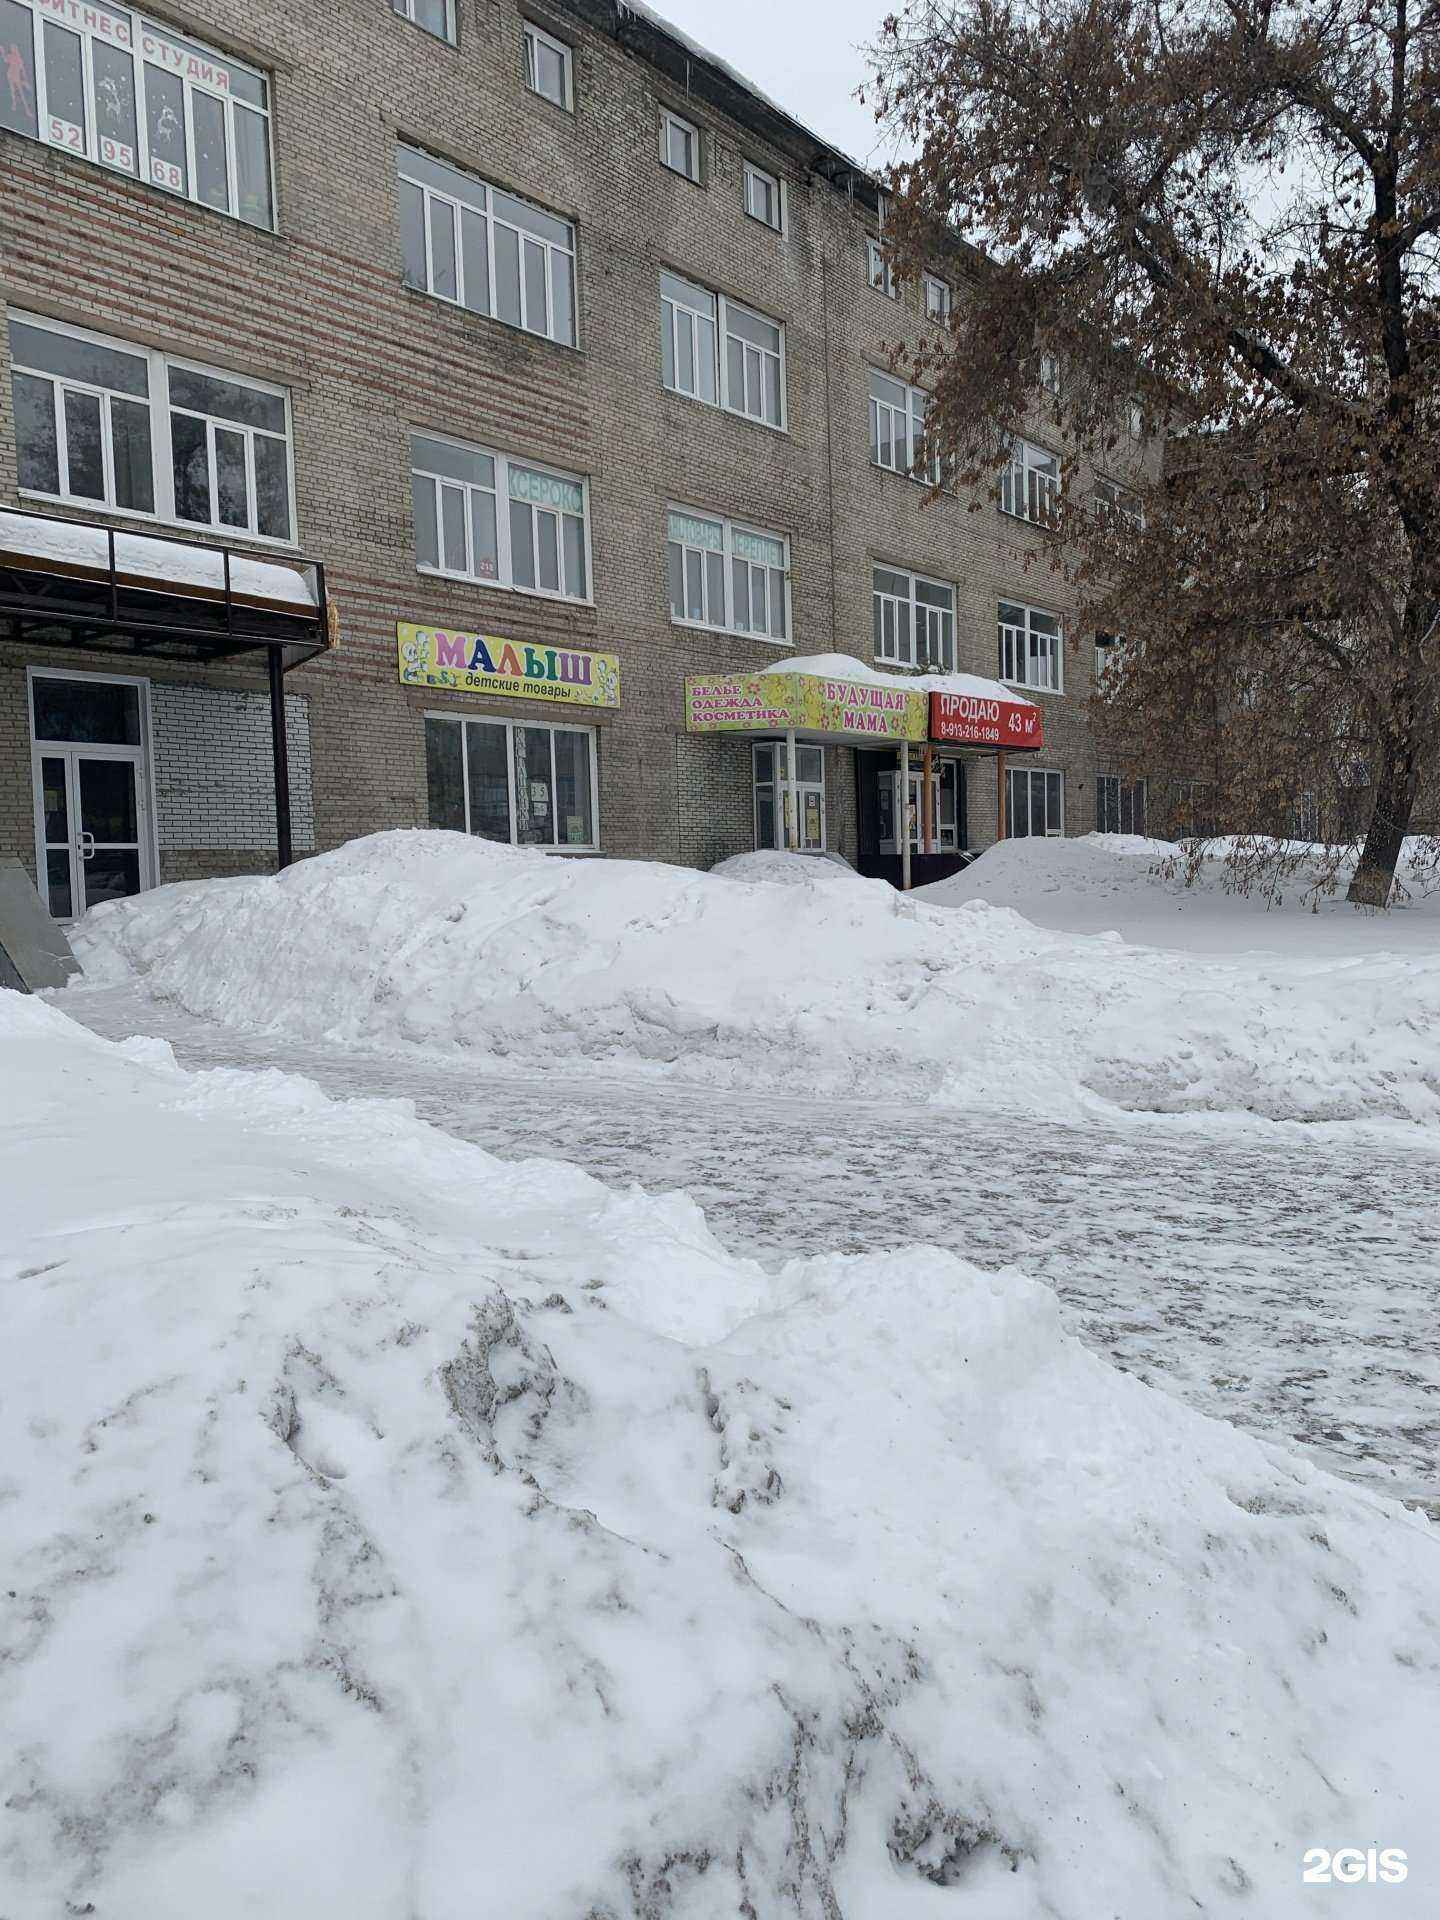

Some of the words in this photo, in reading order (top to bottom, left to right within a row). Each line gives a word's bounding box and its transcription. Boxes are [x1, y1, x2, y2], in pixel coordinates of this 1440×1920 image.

[142, 36, 229, 90] СТУДИЯ
[51, 119, 82, 147] 52
[103, 140, 132, 168] 95
[152, 161, 181, 188] 68
[435, 632, 592, 685] МАЛЫШ
[465, 672, 520, 692] детские
[523, 682, 571, 698] товары
[692, 685, 742, 697] БЕЛЬЕ
[826, 682, 905, 711] БУДУЩАЯ
[692, 698, 763, 710] ОДЕЖДА
[692, 709, 790, 722] КОСМЕТИКА
[940, 695, 999, 723] ПРОДАЮ
[843, 710, 888, 733] МАМА
[941, 722, 999, 741] 8-913-216-1849
[1008, 712, 1022, 732] 43
